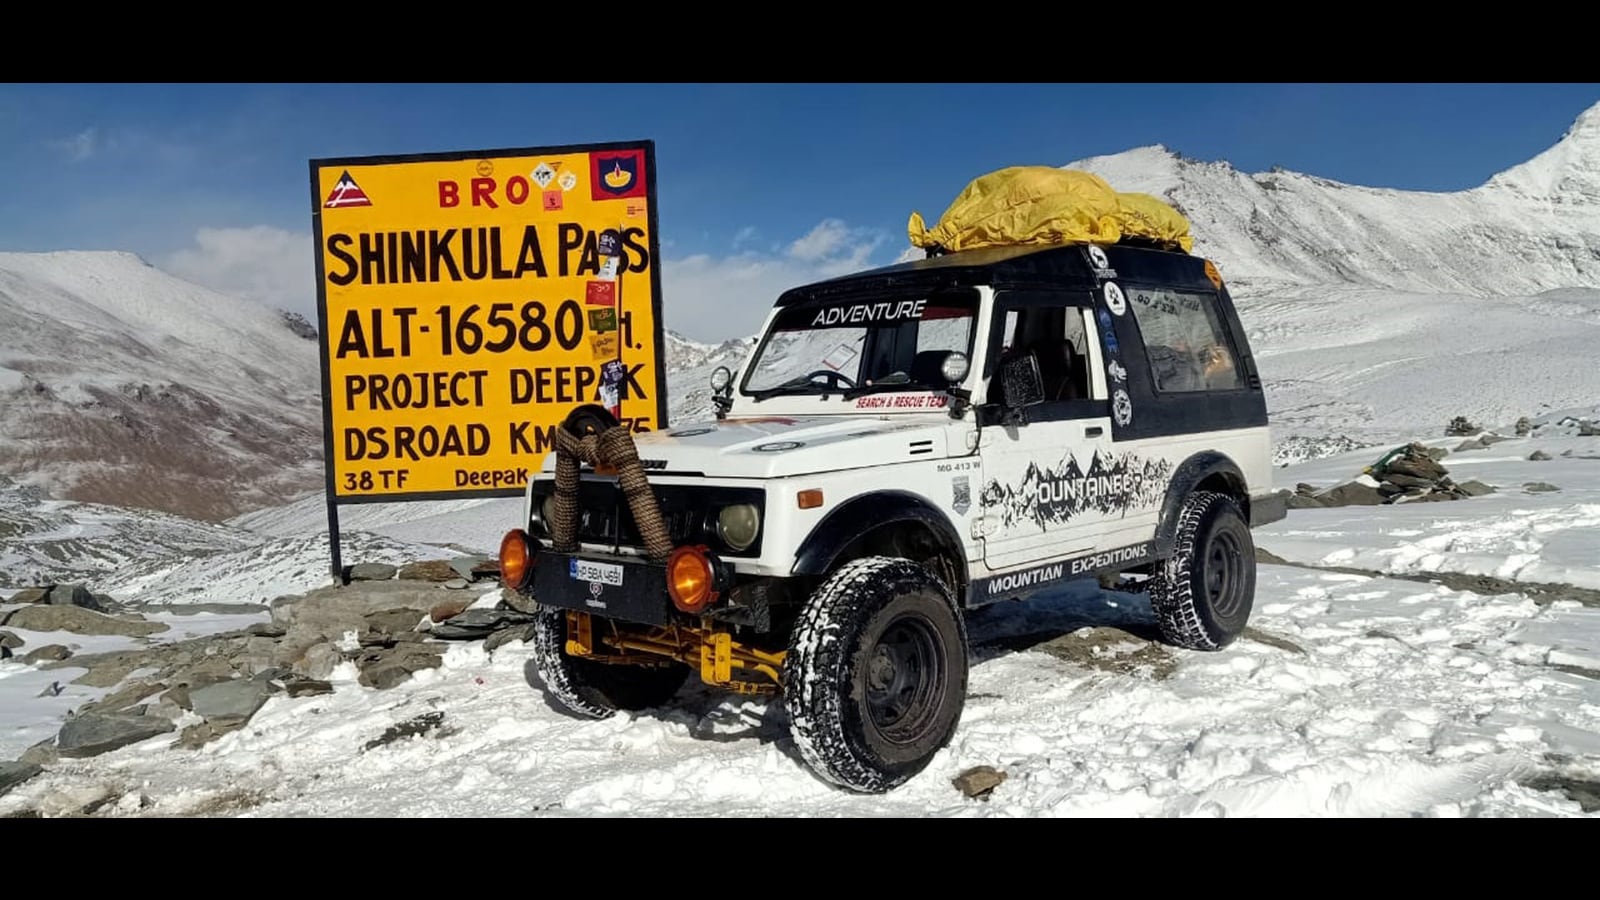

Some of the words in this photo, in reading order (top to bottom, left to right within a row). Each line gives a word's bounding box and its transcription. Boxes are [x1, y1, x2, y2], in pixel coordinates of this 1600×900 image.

[438, 175, 530, 209] BRO
[327, 225, 548, 286] SHINKULA
[335, 299, 584, 359] ALT-16580
[812, 299, 927, 326] ADVENTURE
[345, 370, 489, 411] PROJECT
[856, 397, 886, 409] SEARCH
[894, 396, 926, 408] RESCUE
[926, 395, 949, 408] TEAM
[988, 564, 1063, 594] MOUNTIAN
[1071, 545, 1147, 574] EXPEDITIONS
